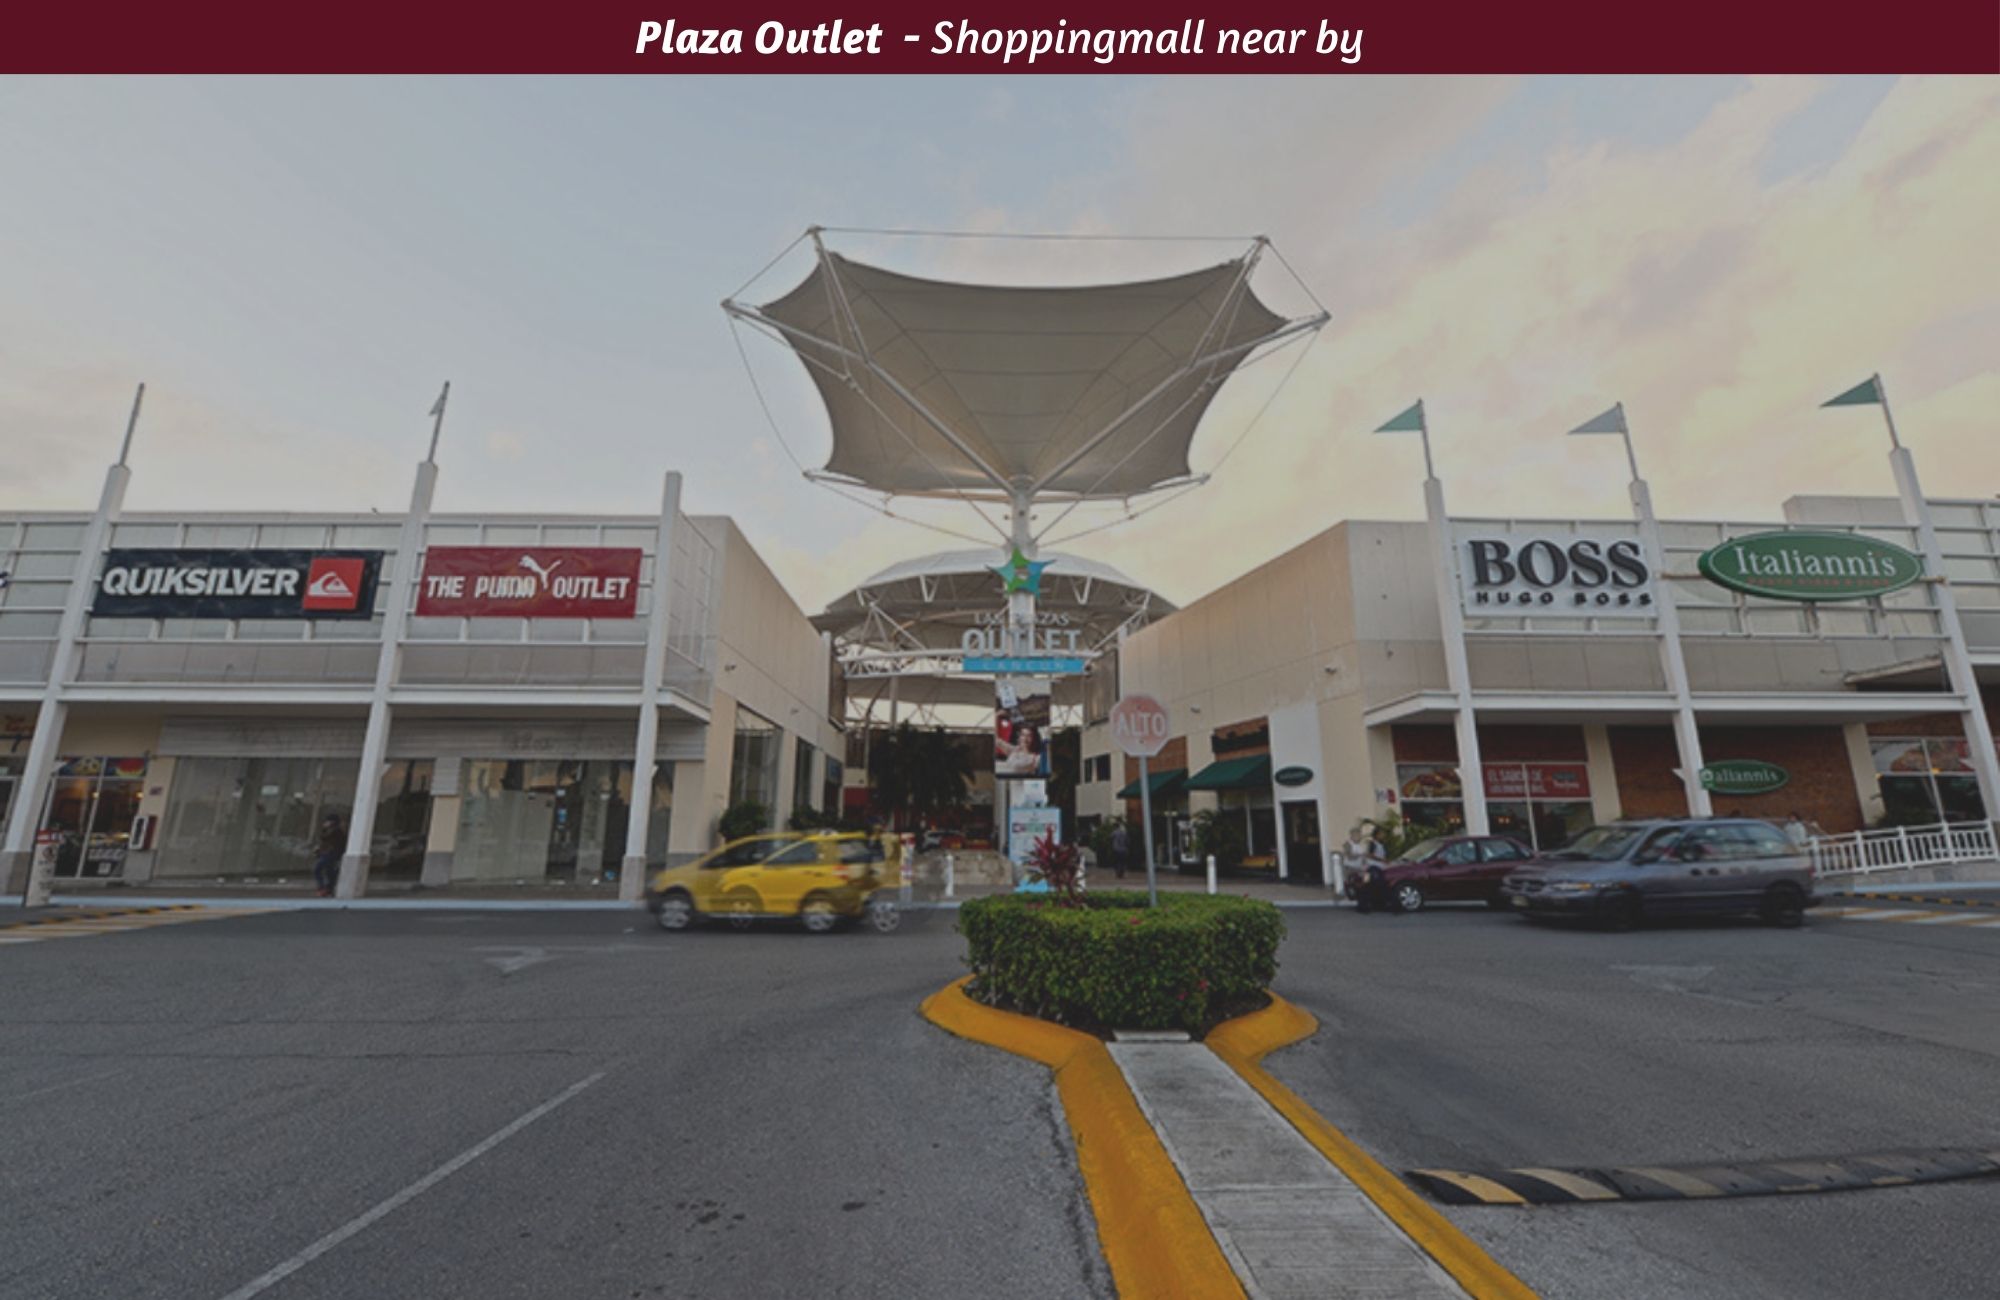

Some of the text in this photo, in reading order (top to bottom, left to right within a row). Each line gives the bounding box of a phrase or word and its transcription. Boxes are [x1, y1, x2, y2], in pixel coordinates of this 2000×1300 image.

[1468, 540, 1648, 588] BOSS
[103, 567, 299, 596] QUIKSILVER
[427, 576, 630, 599] THE PUMA OUTLET
[1476, 591, 1652, 606] HUGO BOSS
[962, 628, 1082, 657] OUTLET
[1113, 712, 1166, 736] ALTO
[1715, 768, 1779, 783] aliannis
